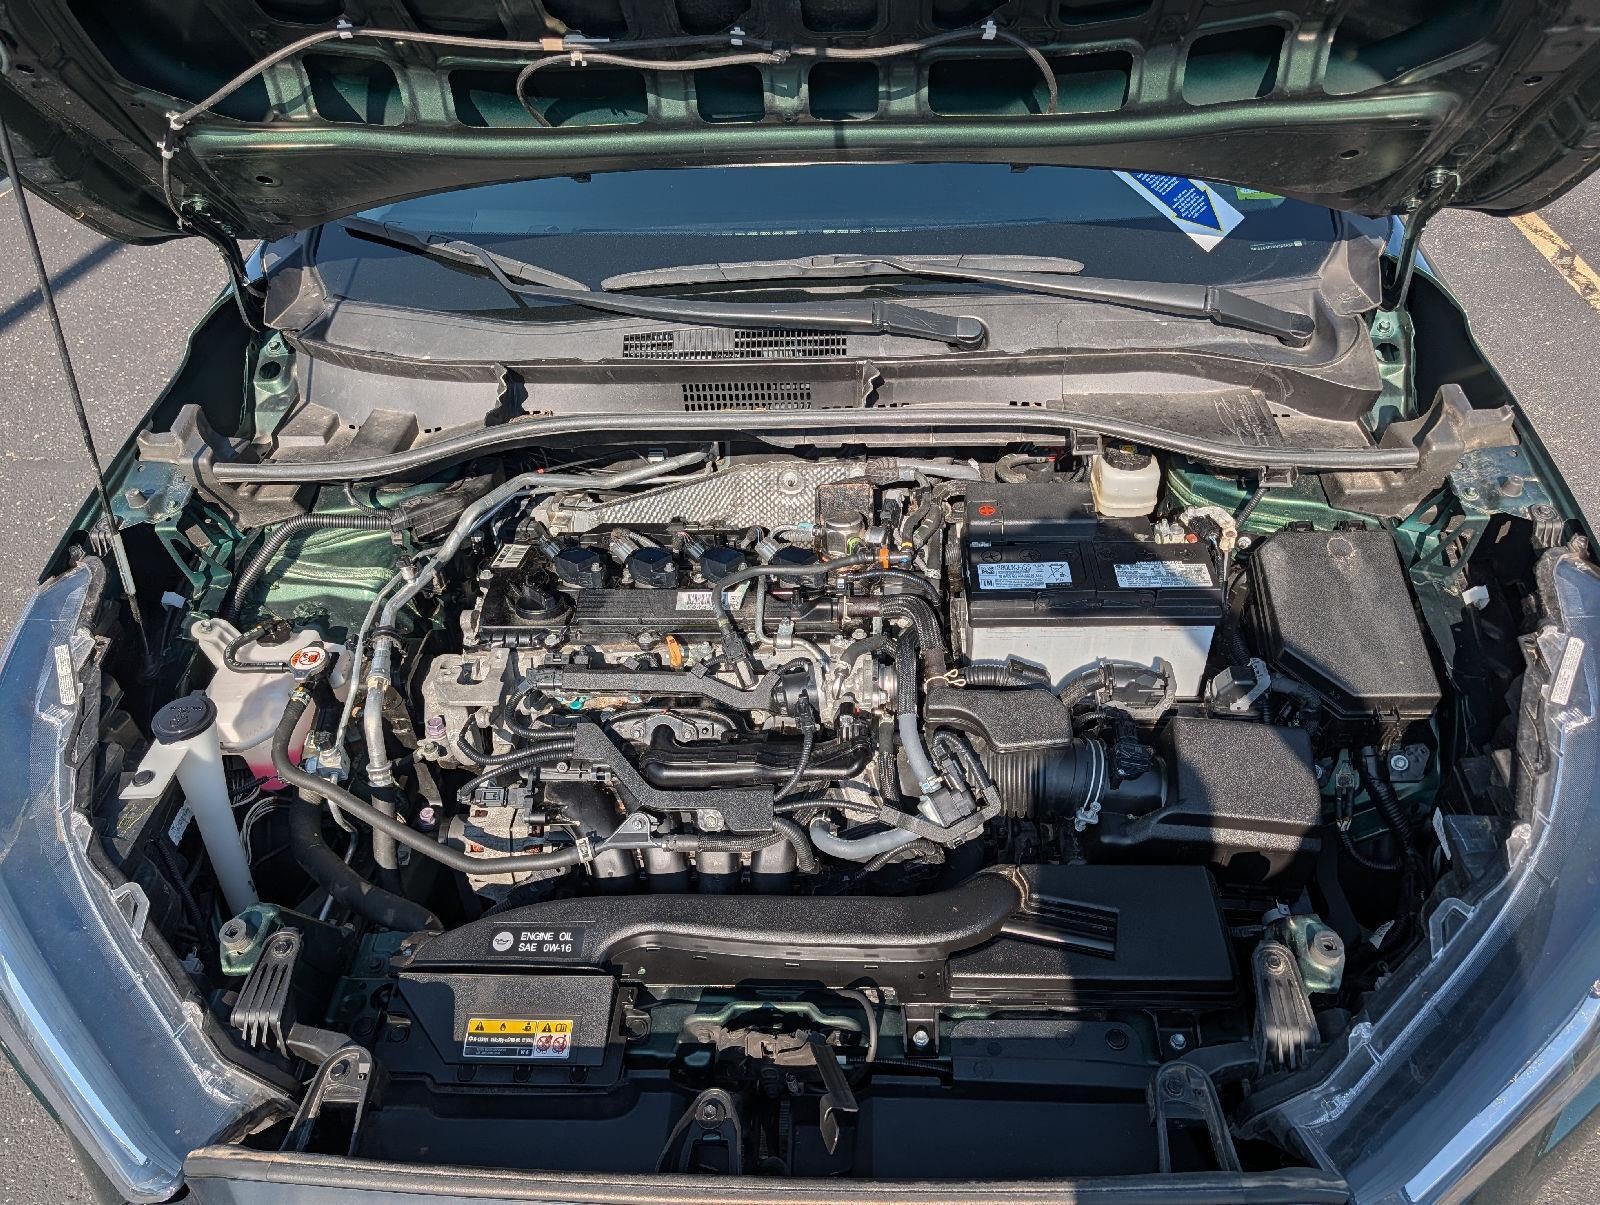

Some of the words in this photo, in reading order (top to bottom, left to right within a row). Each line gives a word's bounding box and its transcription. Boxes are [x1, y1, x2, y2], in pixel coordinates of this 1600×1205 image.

[520, 931, 554, 941] ENGINE
[559, 932, 574, 941] OIL
[518, 943, 537, 952] SAE
[543, 943, 572, 953] 0W-16
